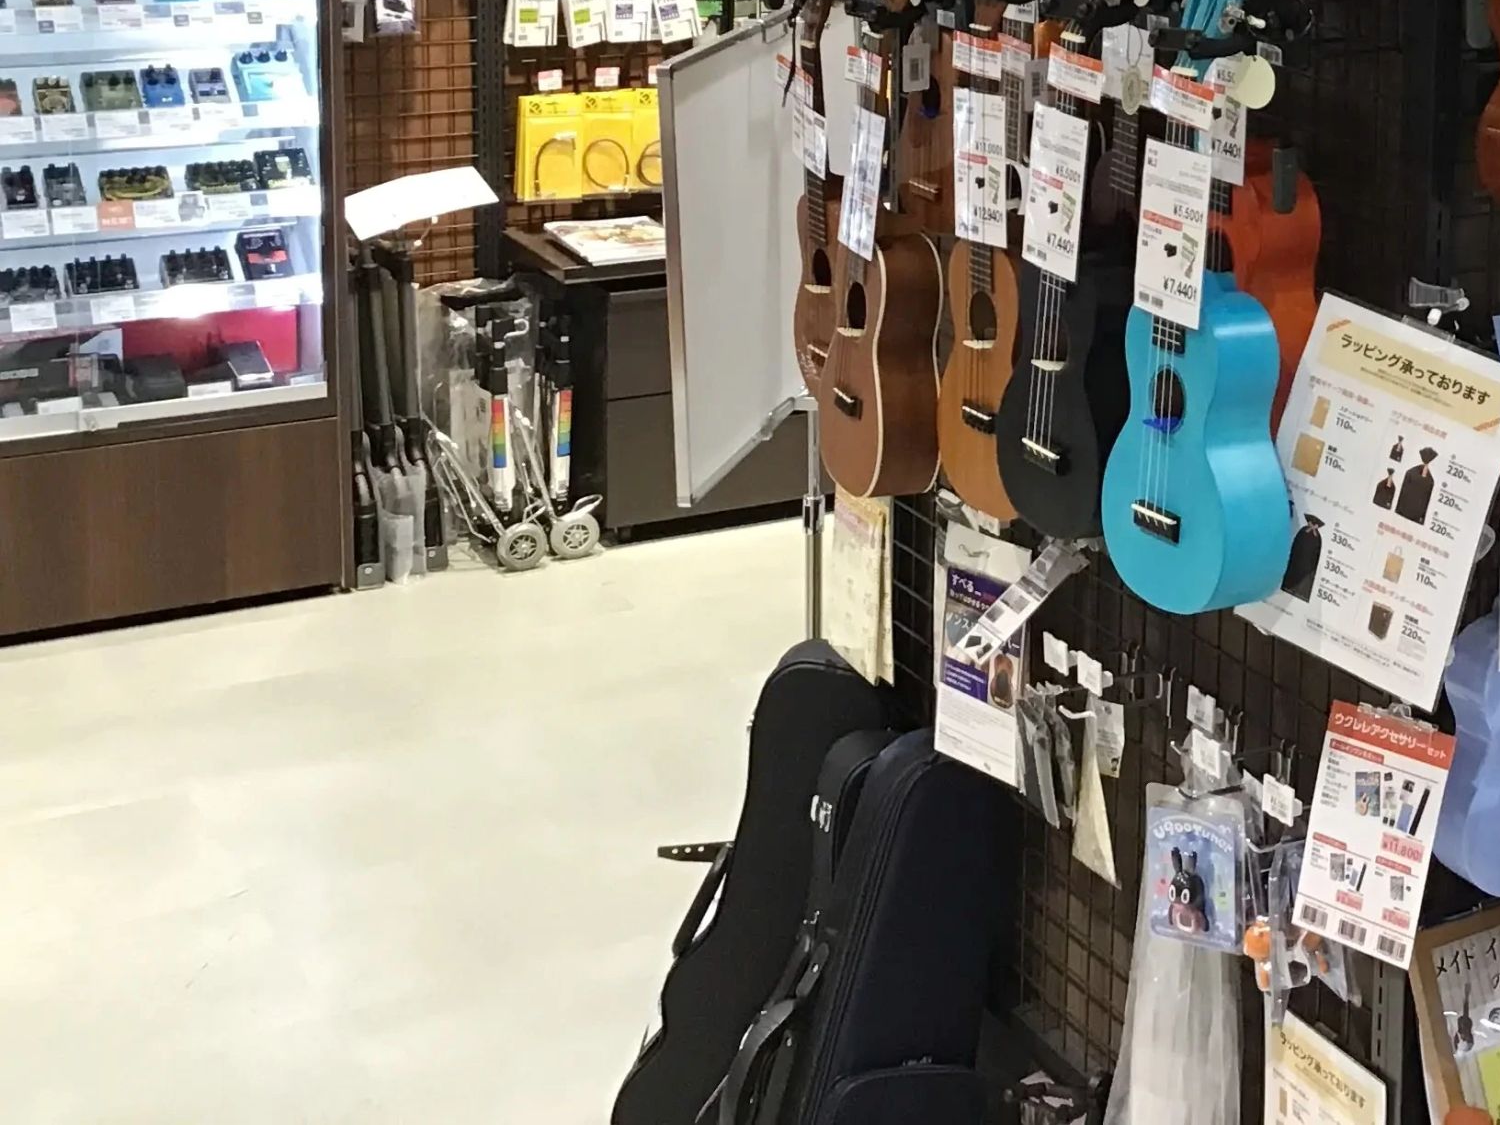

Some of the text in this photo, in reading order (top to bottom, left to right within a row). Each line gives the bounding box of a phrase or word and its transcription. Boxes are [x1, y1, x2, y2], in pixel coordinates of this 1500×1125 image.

[1341, 333, 1491, 405] ラッピング承っております
[1436, 948, 1475, 978] メイド
